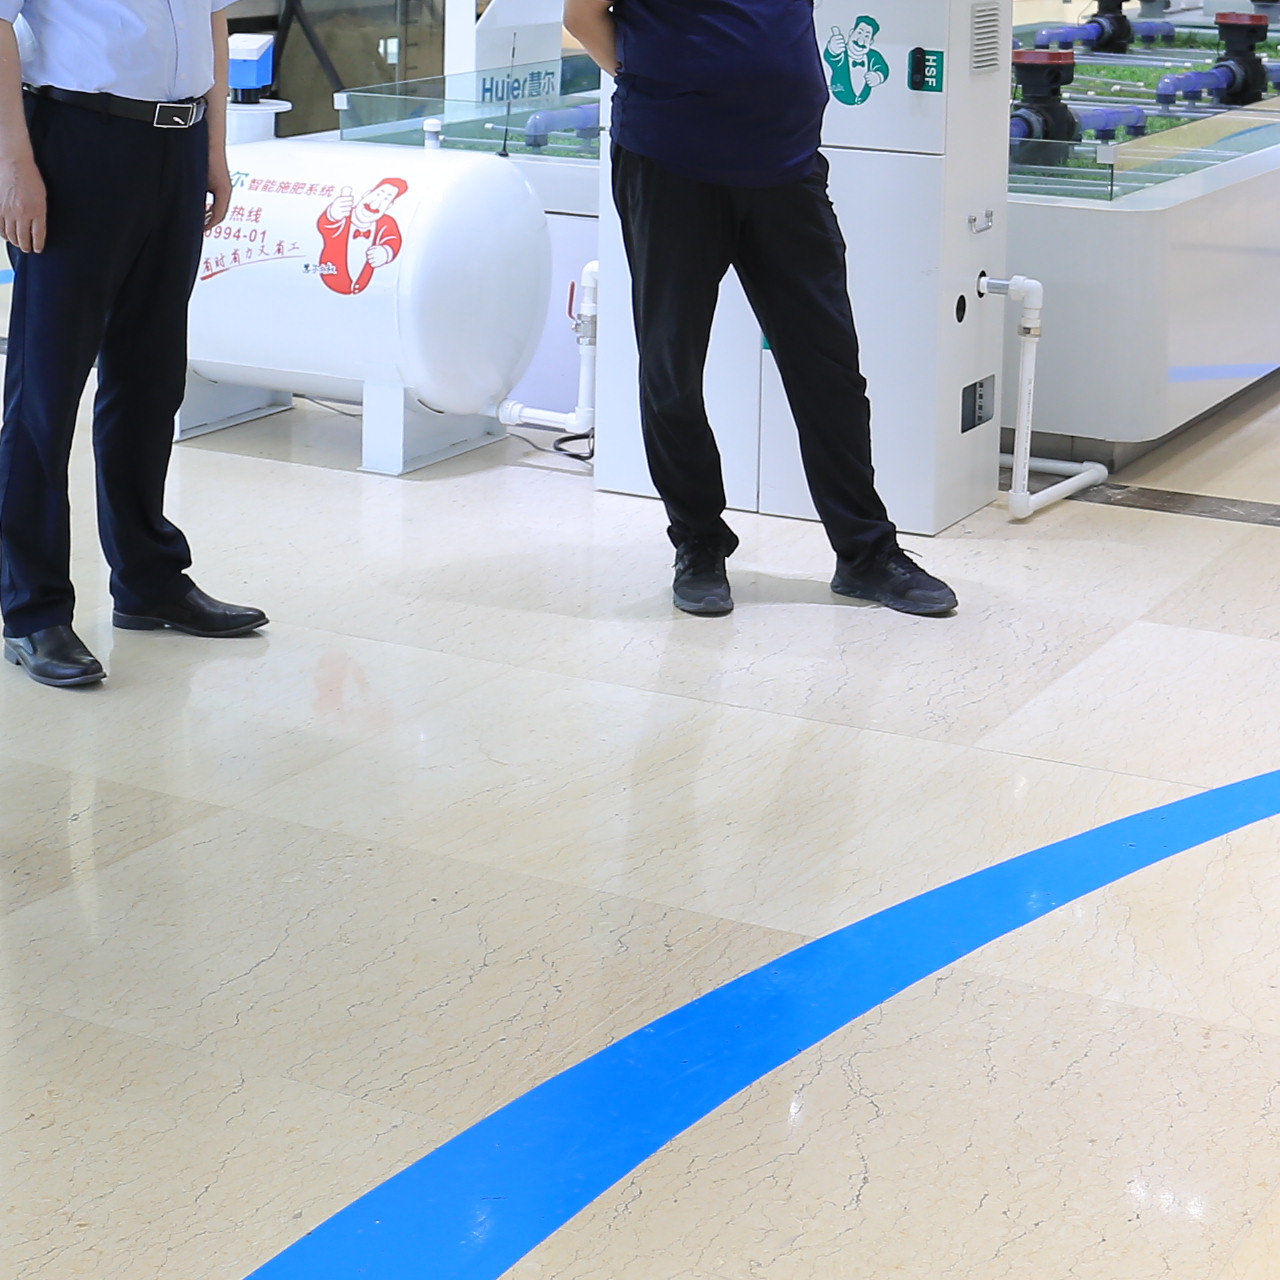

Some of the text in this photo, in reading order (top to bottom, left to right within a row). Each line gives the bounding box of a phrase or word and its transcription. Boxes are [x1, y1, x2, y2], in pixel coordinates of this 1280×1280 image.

[924, 55, 937, 87] HSF
[248, 178, 335, 198] 智能施肥系统
[229, 205, 263, 223] 热线
